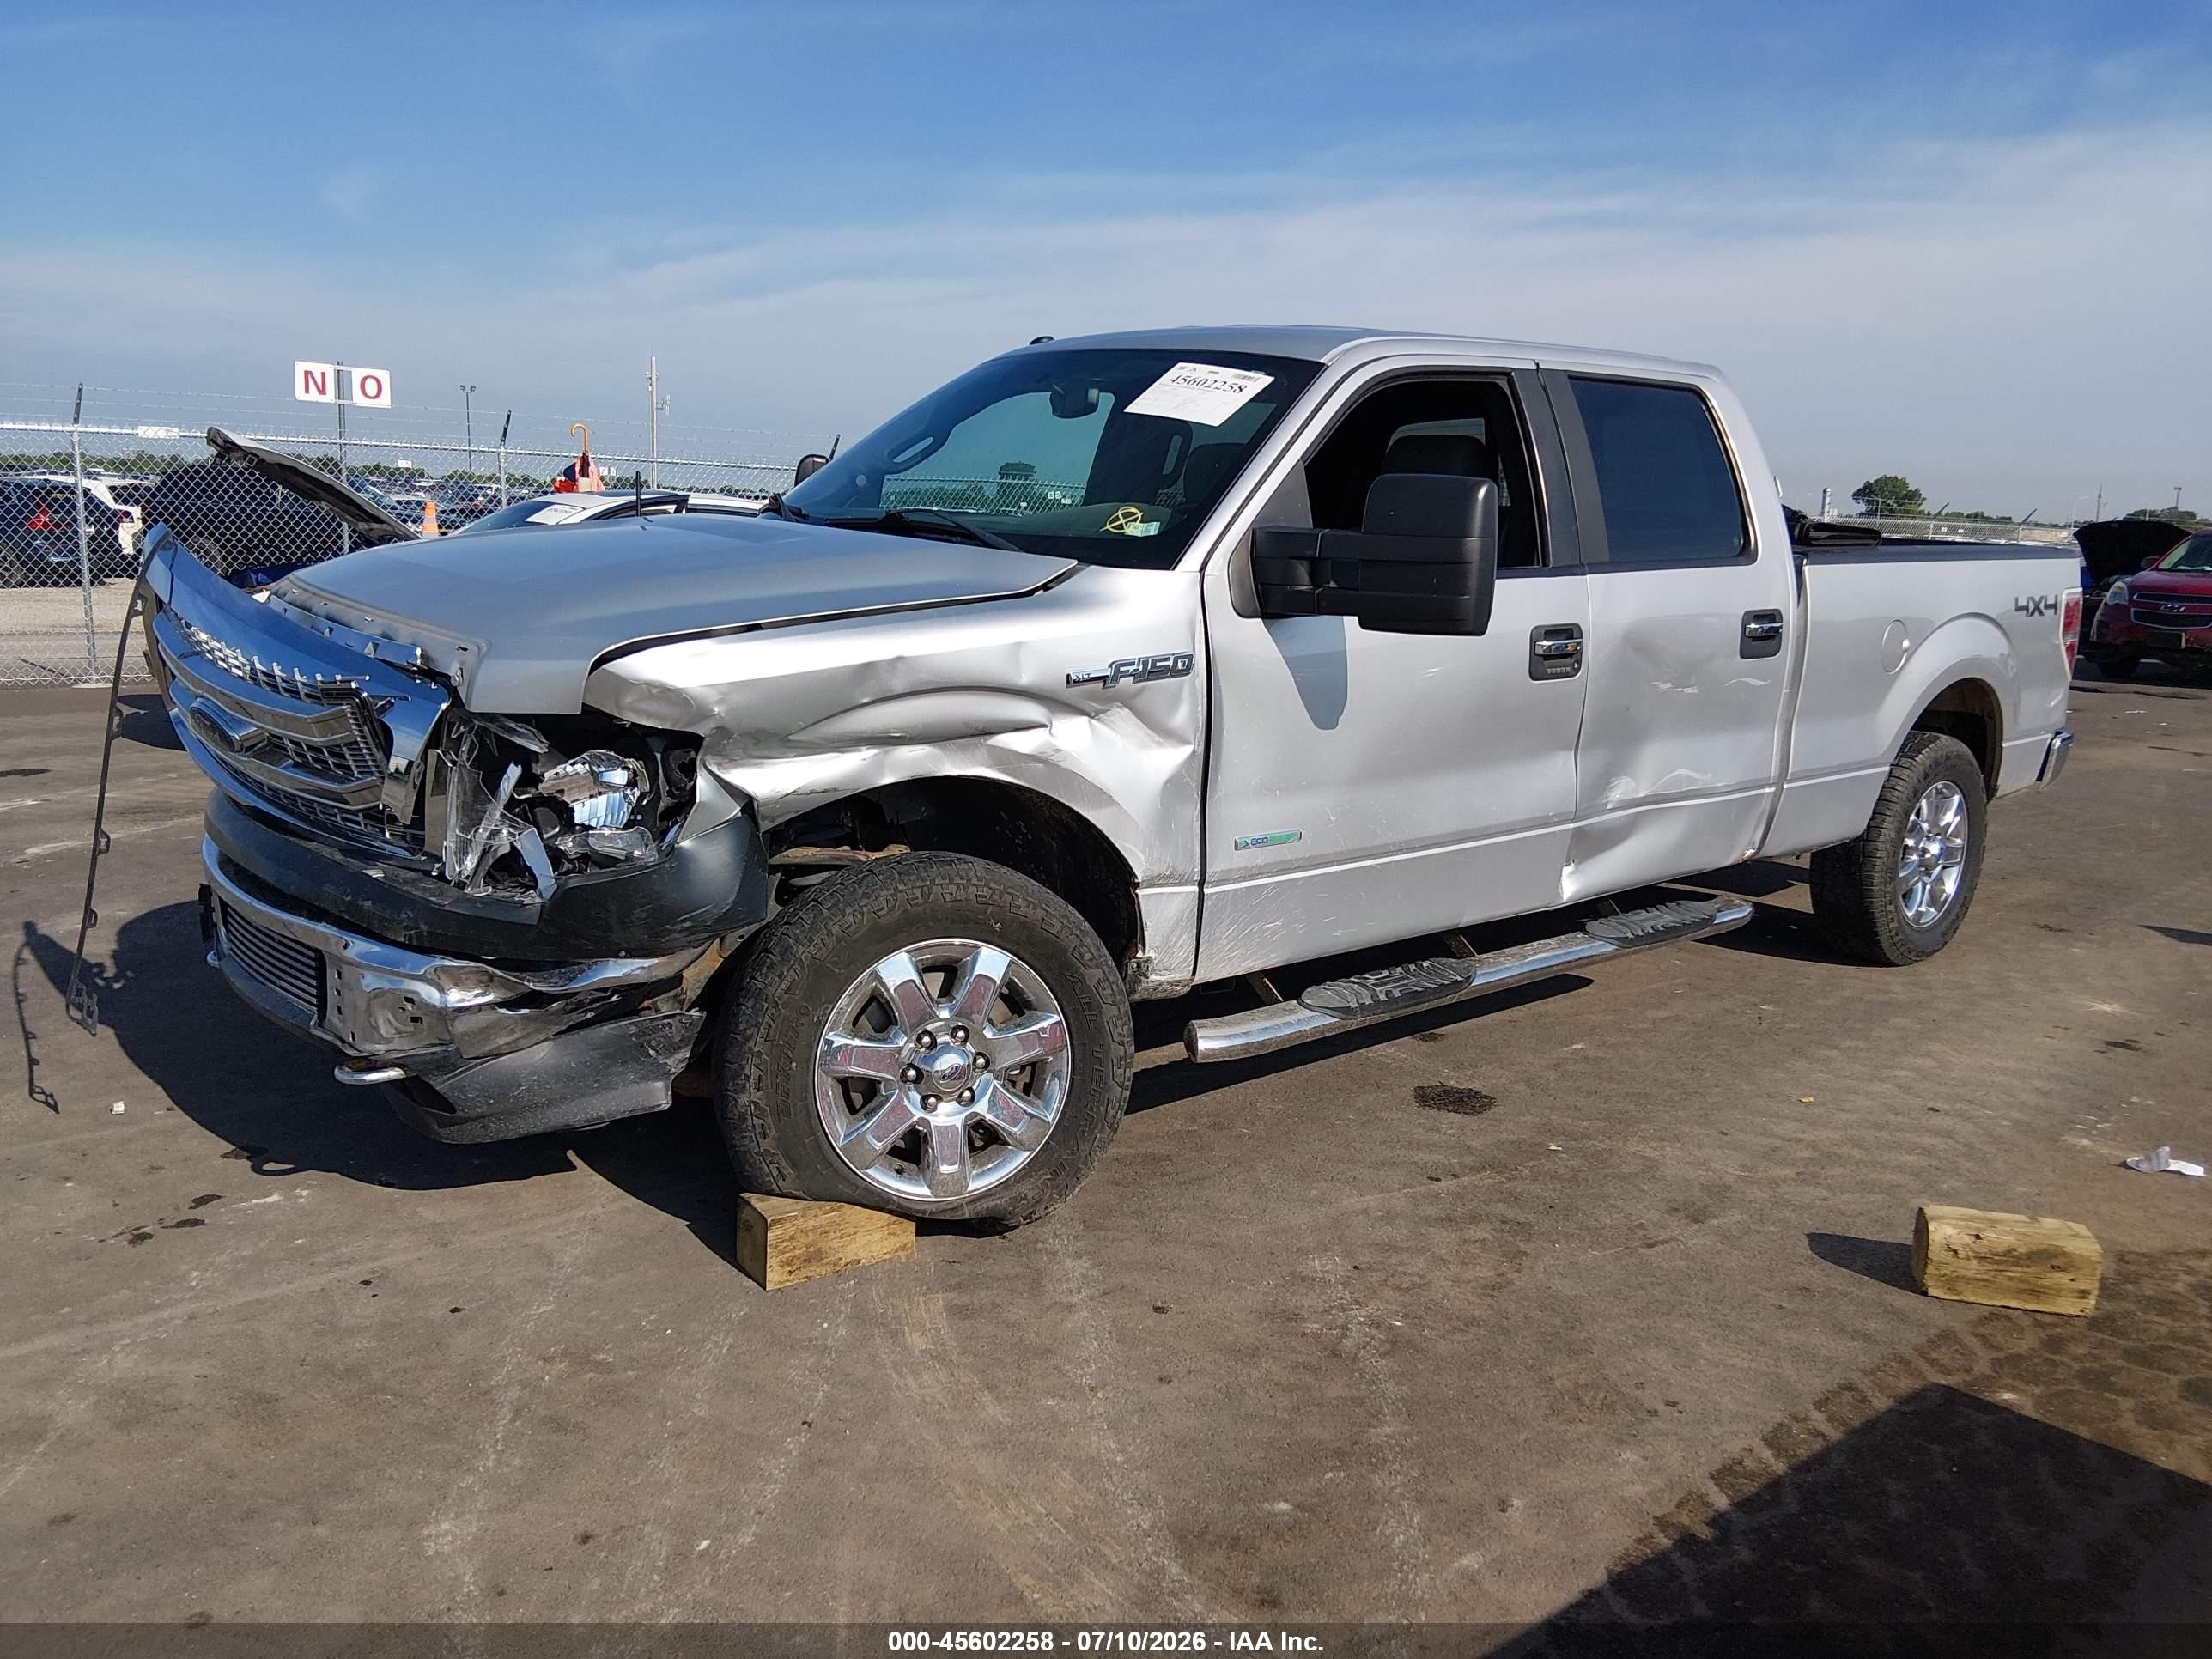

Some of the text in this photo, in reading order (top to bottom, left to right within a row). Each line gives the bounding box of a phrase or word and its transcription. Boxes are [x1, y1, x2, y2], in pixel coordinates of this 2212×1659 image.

[304, 370, 383, 400] N O
[1170, 374, 1248, 394] 45602258
[2014, 594, 2058, 618] 4X4
[1074, 653, 1194, 689] XLT F-150
[1064, 972, 1098, 1030] ALL
